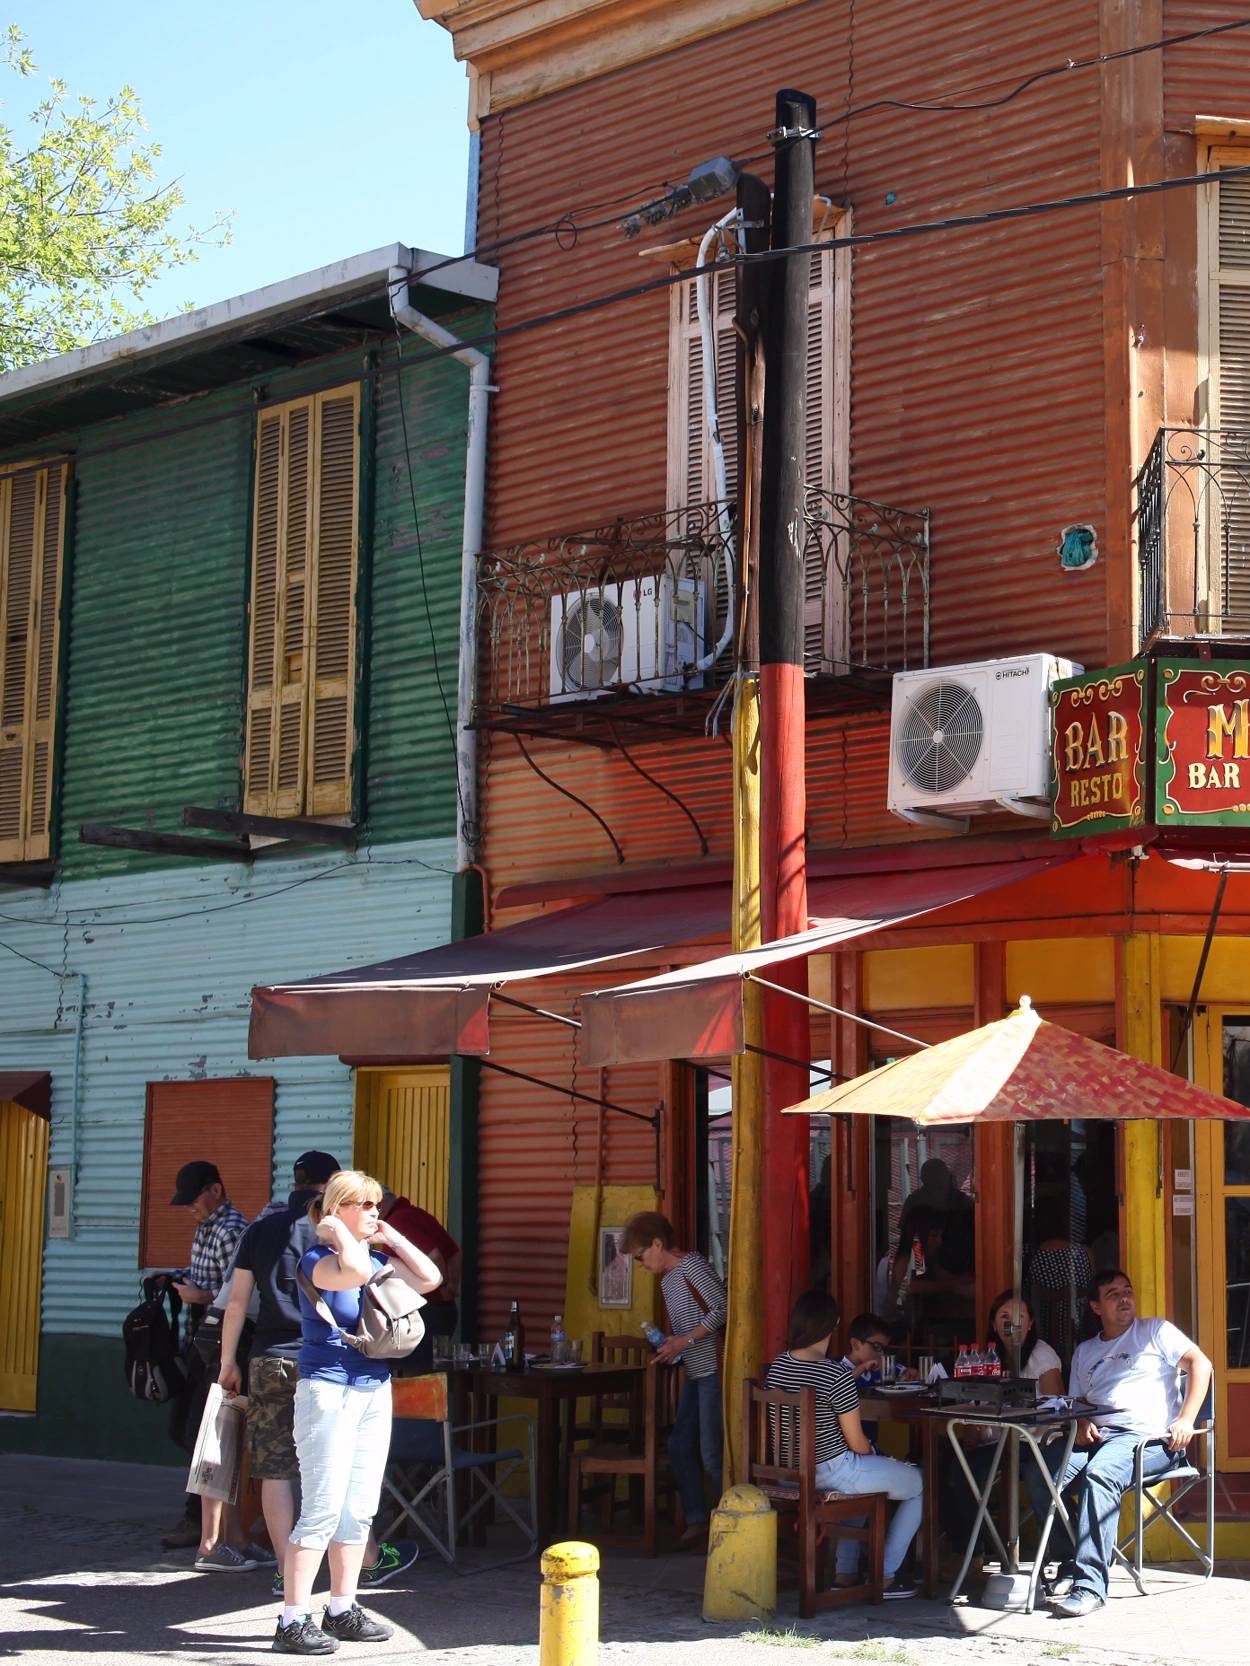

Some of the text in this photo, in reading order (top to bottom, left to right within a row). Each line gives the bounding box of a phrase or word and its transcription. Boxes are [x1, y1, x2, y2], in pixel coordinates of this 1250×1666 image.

[644, 588, 652, 596] LG
[1002, 667, 1030, 678] HITACHI
[1065, 711, 1128, 771] BAR
[1070, 773, 1123, 807] RESTO
[1187, 763, 1241, 791] BAR
